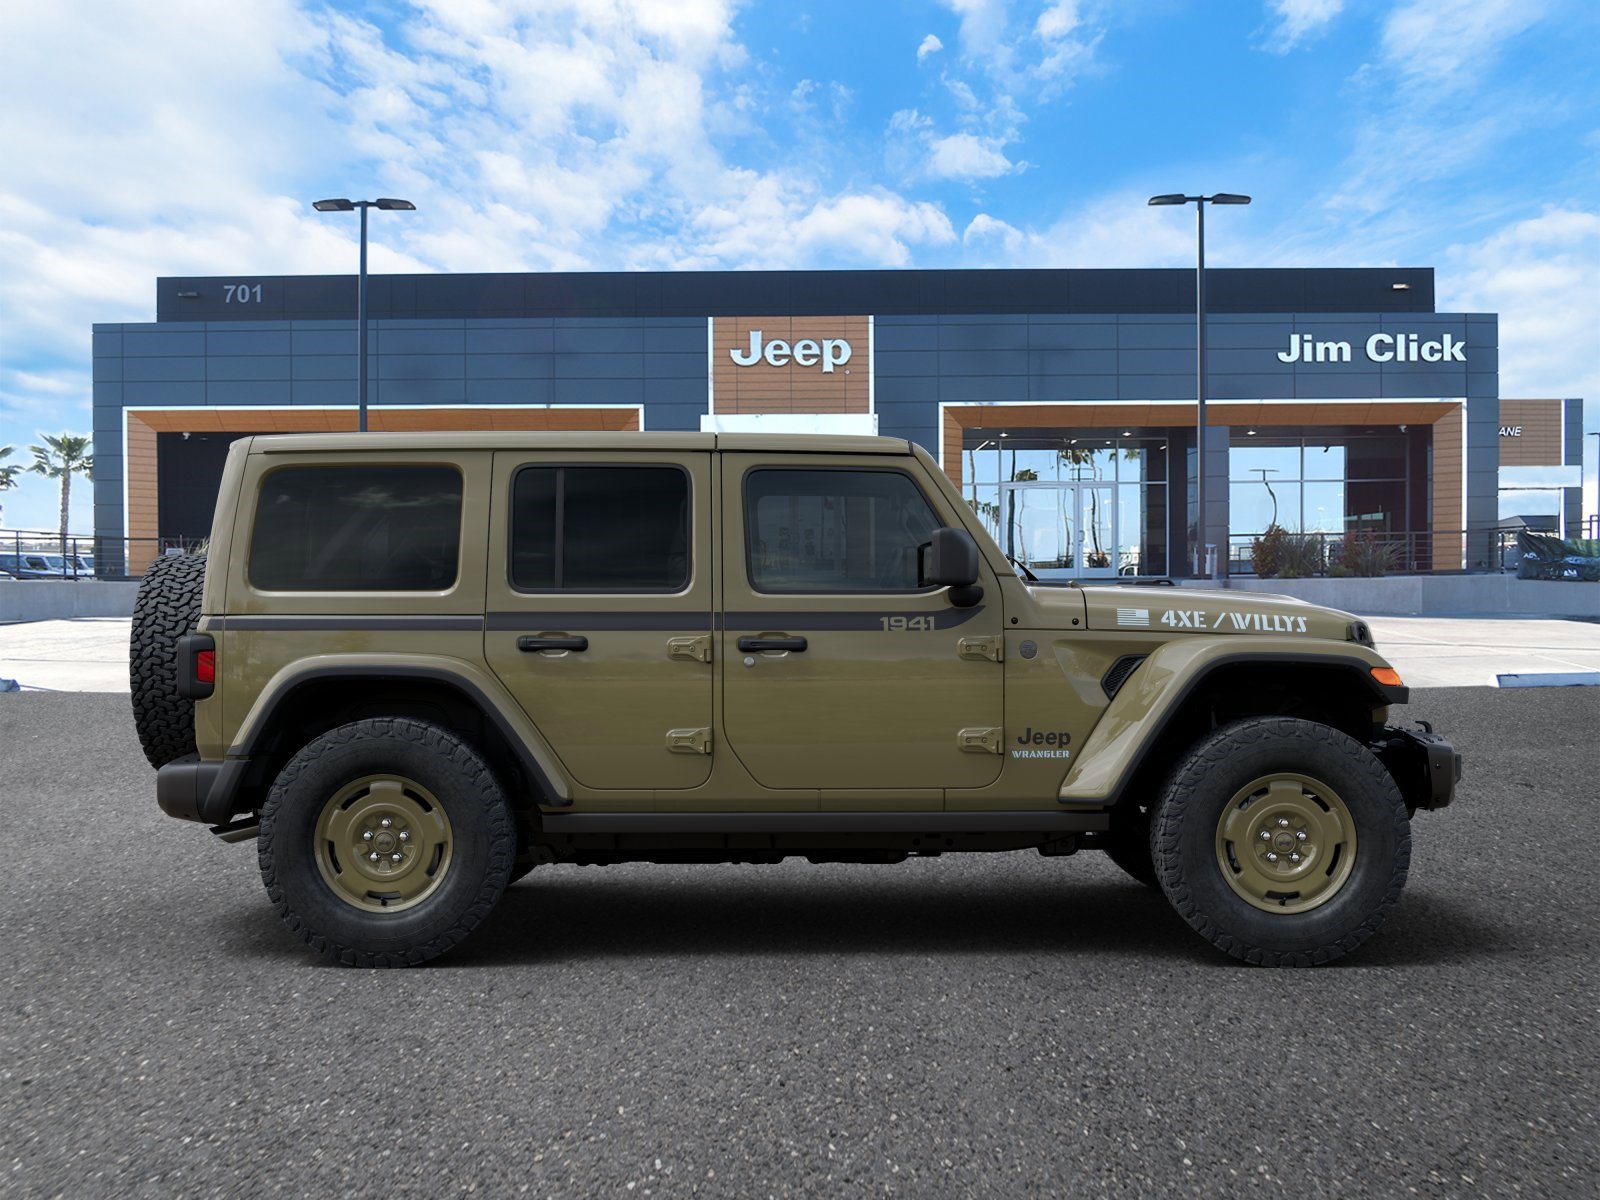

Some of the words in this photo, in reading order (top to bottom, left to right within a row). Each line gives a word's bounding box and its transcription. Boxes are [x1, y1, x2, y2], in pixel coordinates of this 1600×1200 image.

[223, 284, 261, 303] 701
[729, 330, 852, 373] Jeep
[1277, 333, 1351, 362] Jim
[1366, 333, 1467, 362] Click
[879, 615, 935, 632] 1941
[1160, 609, 1207, 628] 4XE
[1017, 727, 1071, 748] Jeep
[1011, 750, 1070, 759] WRANGLER
